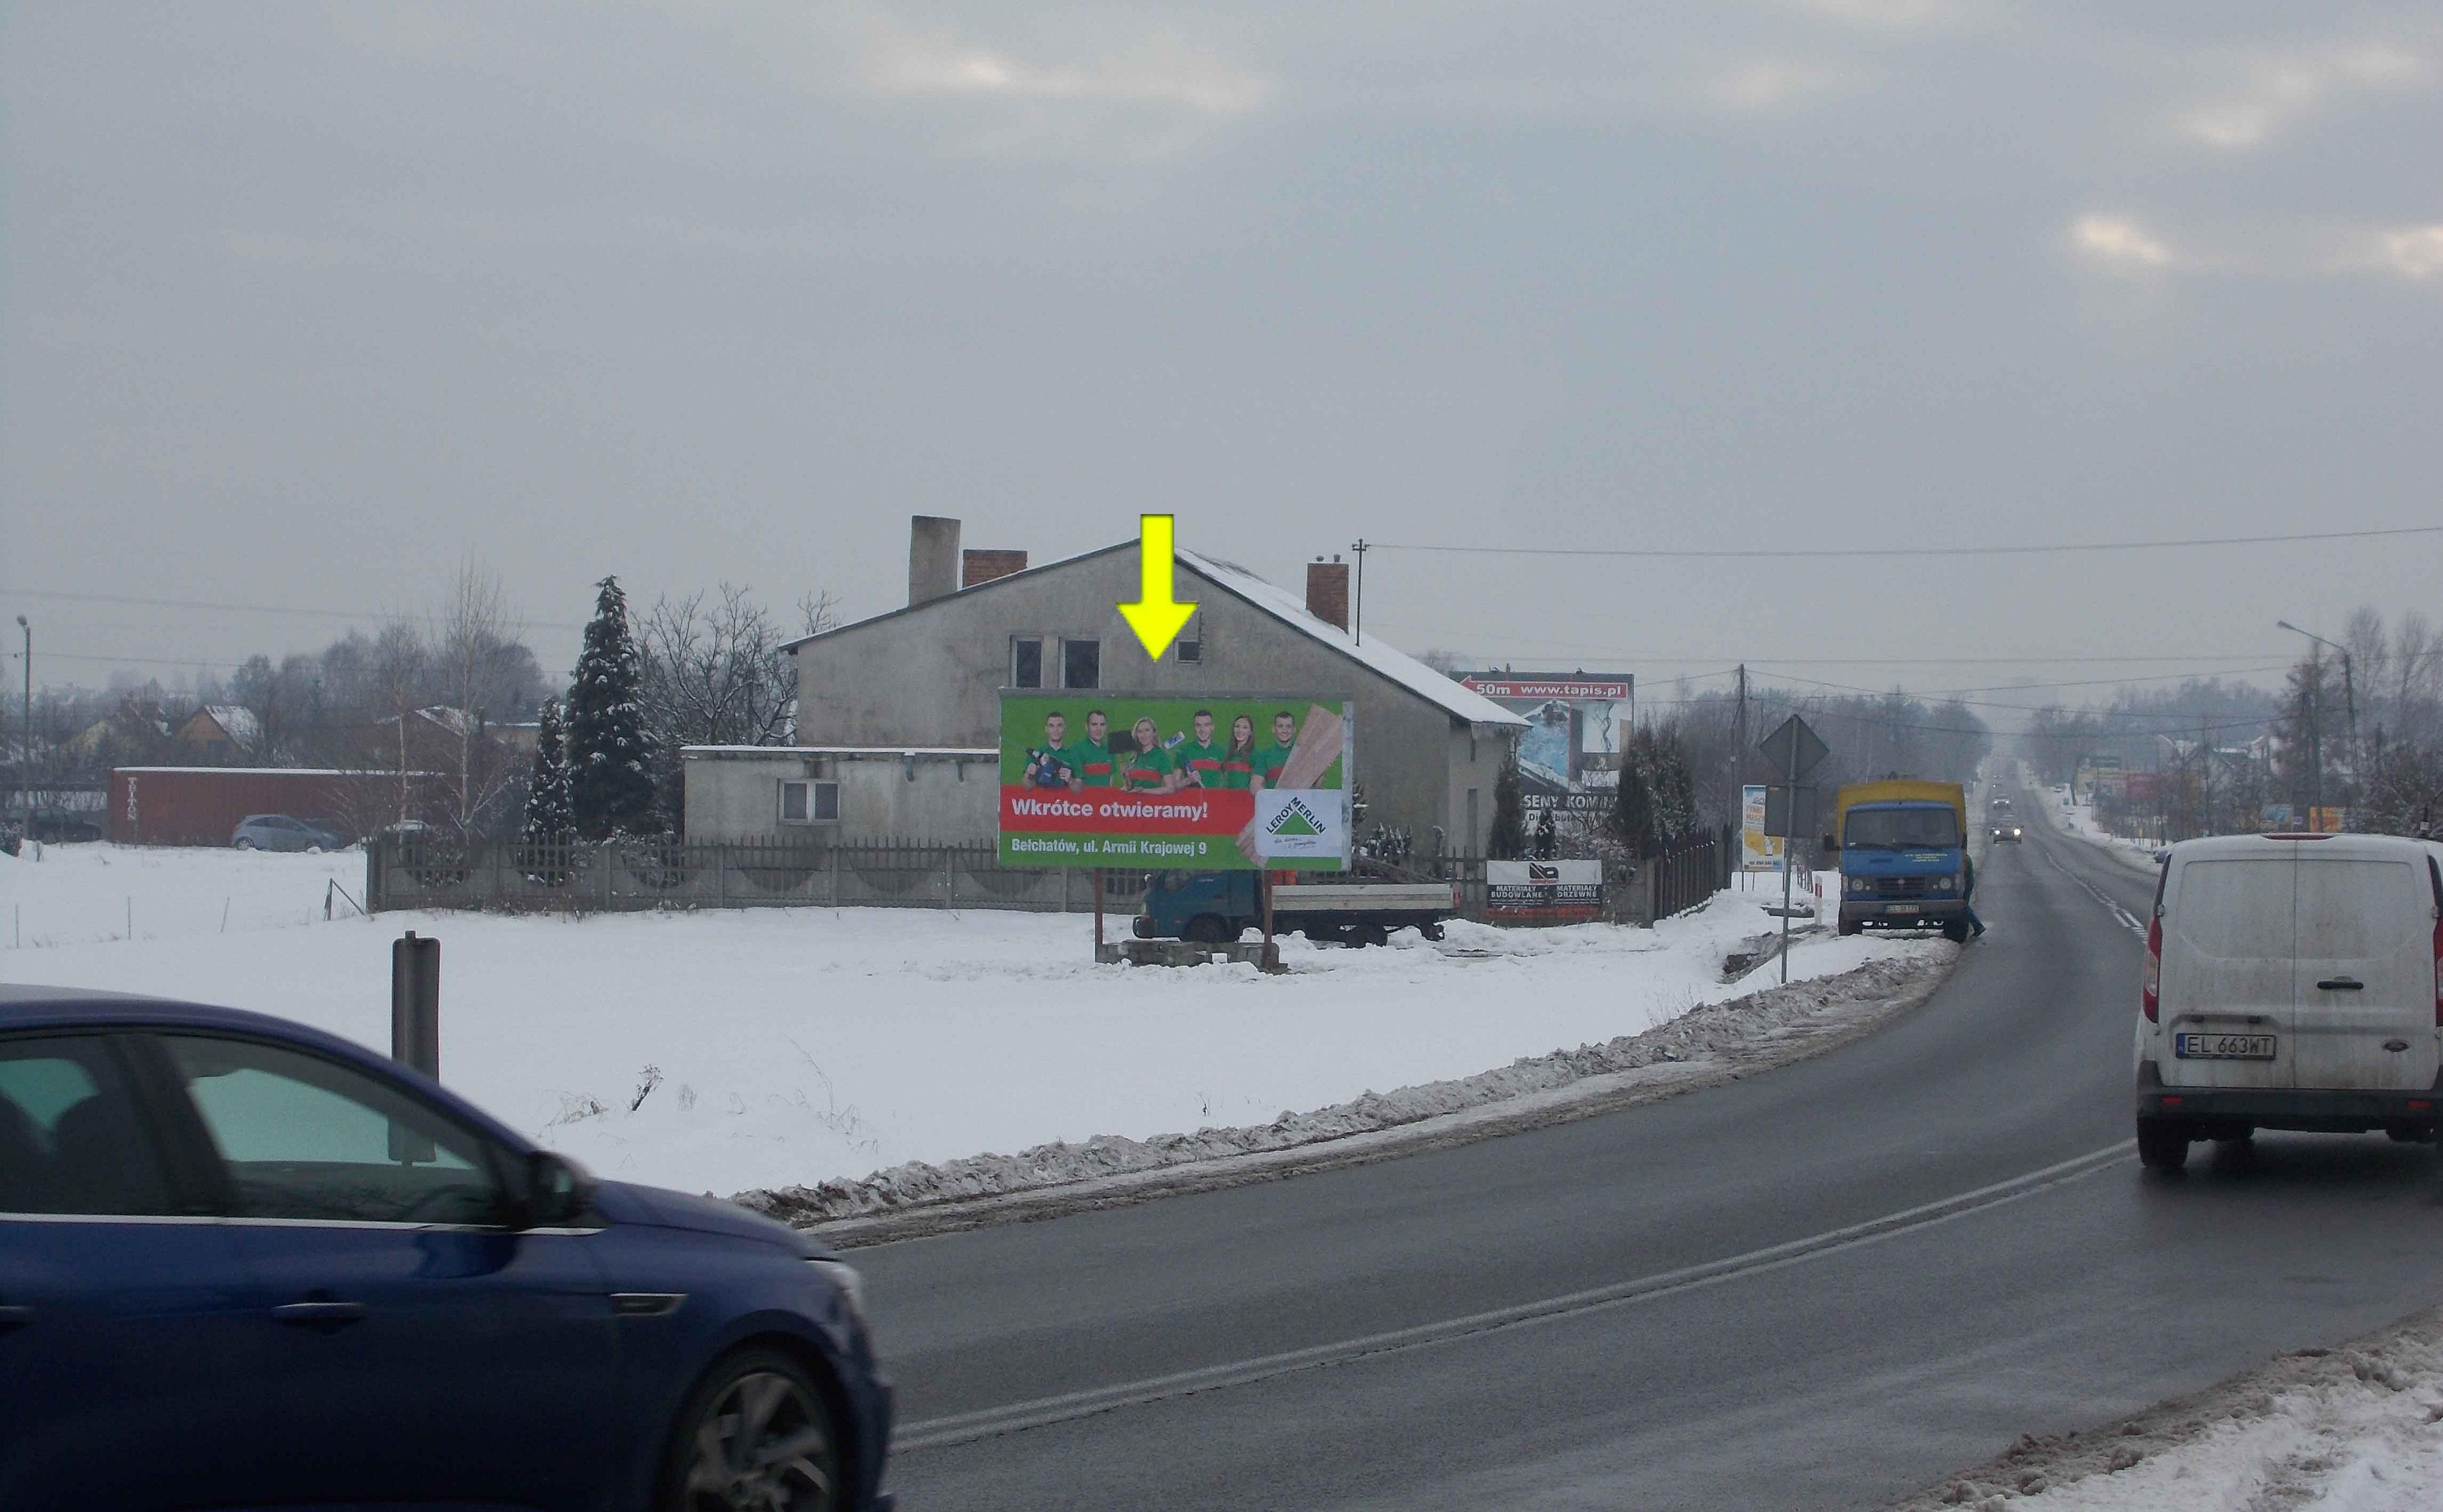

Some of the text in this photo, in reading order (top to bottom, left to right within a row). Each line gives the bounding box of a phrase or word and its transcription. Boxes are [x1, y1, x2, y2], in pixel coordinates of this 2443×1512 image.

[1476, 684, 1621, 697] 50m www.tapis.pl
[128, 777, 137, 820] TRITON
[1523, 794, 1558, 808] SENY
[1012, 799, 1208, 822] Wkrótce otwieramy!
[1265, 803, 1294, 833] LEROY
[1290, 797, 1327, 833] MERLIN
[1012, 838, 1207, 857] Bełchatów, ul. Armii Krajowej 9
[2188, 1036, 2270, 1053] EL 663WT
